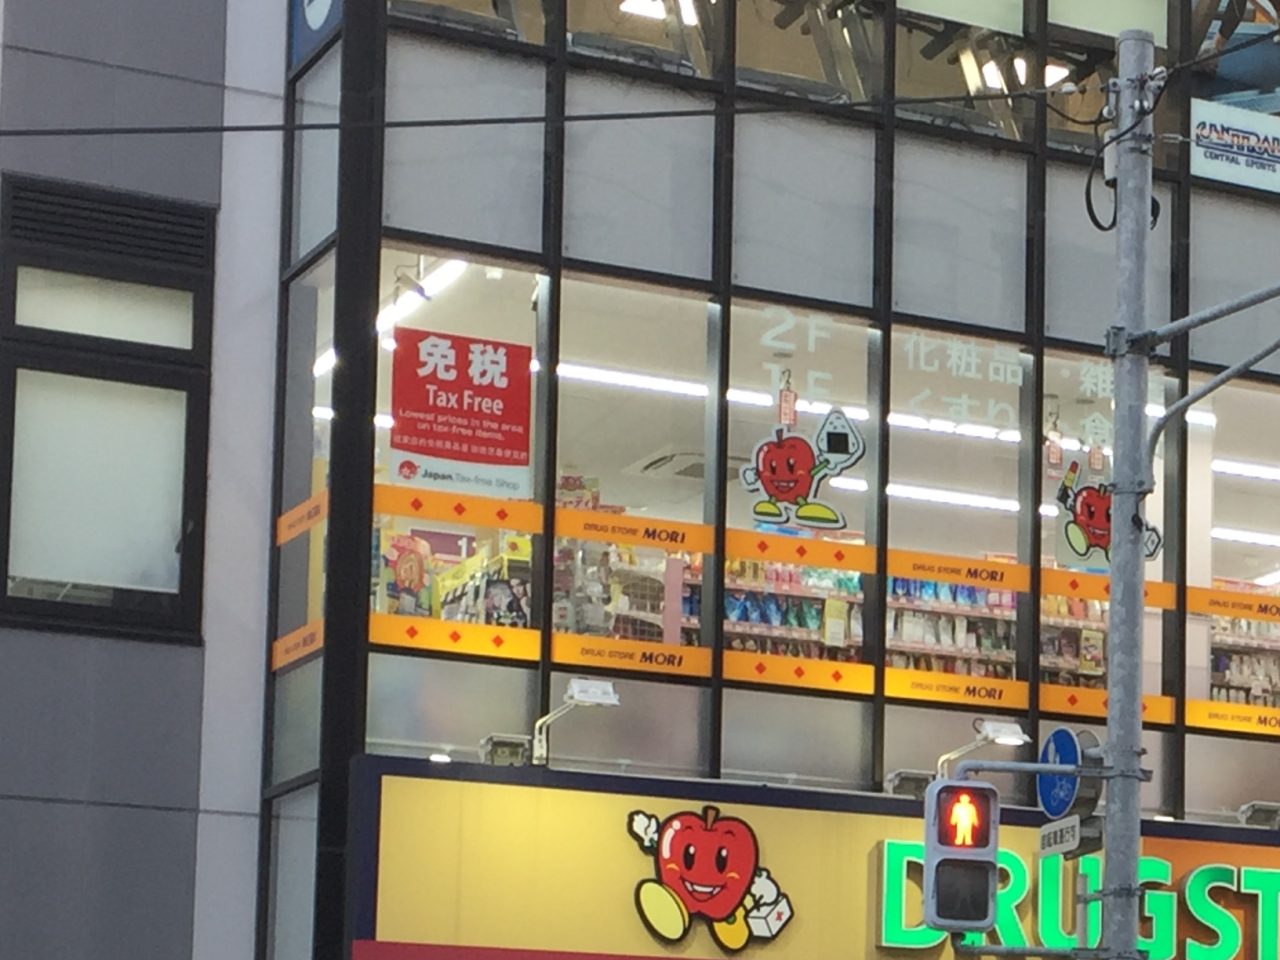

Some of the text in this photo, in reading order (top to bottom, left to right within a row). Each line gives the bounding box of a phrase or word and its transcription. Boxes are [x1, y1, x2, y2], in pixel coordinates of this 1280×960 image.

[1204, 150, 1277, 173] CENTRAL SPORTS
[416, 335, 509, 389] 免税
[426, 384, 504, 415] Tax Free
[643, 527, 686, 544] MORI
[965, 567, 1005, 582] MORI
[640, 650, 683, 667] MORI
[964, 685, 1003, 700] MORI
